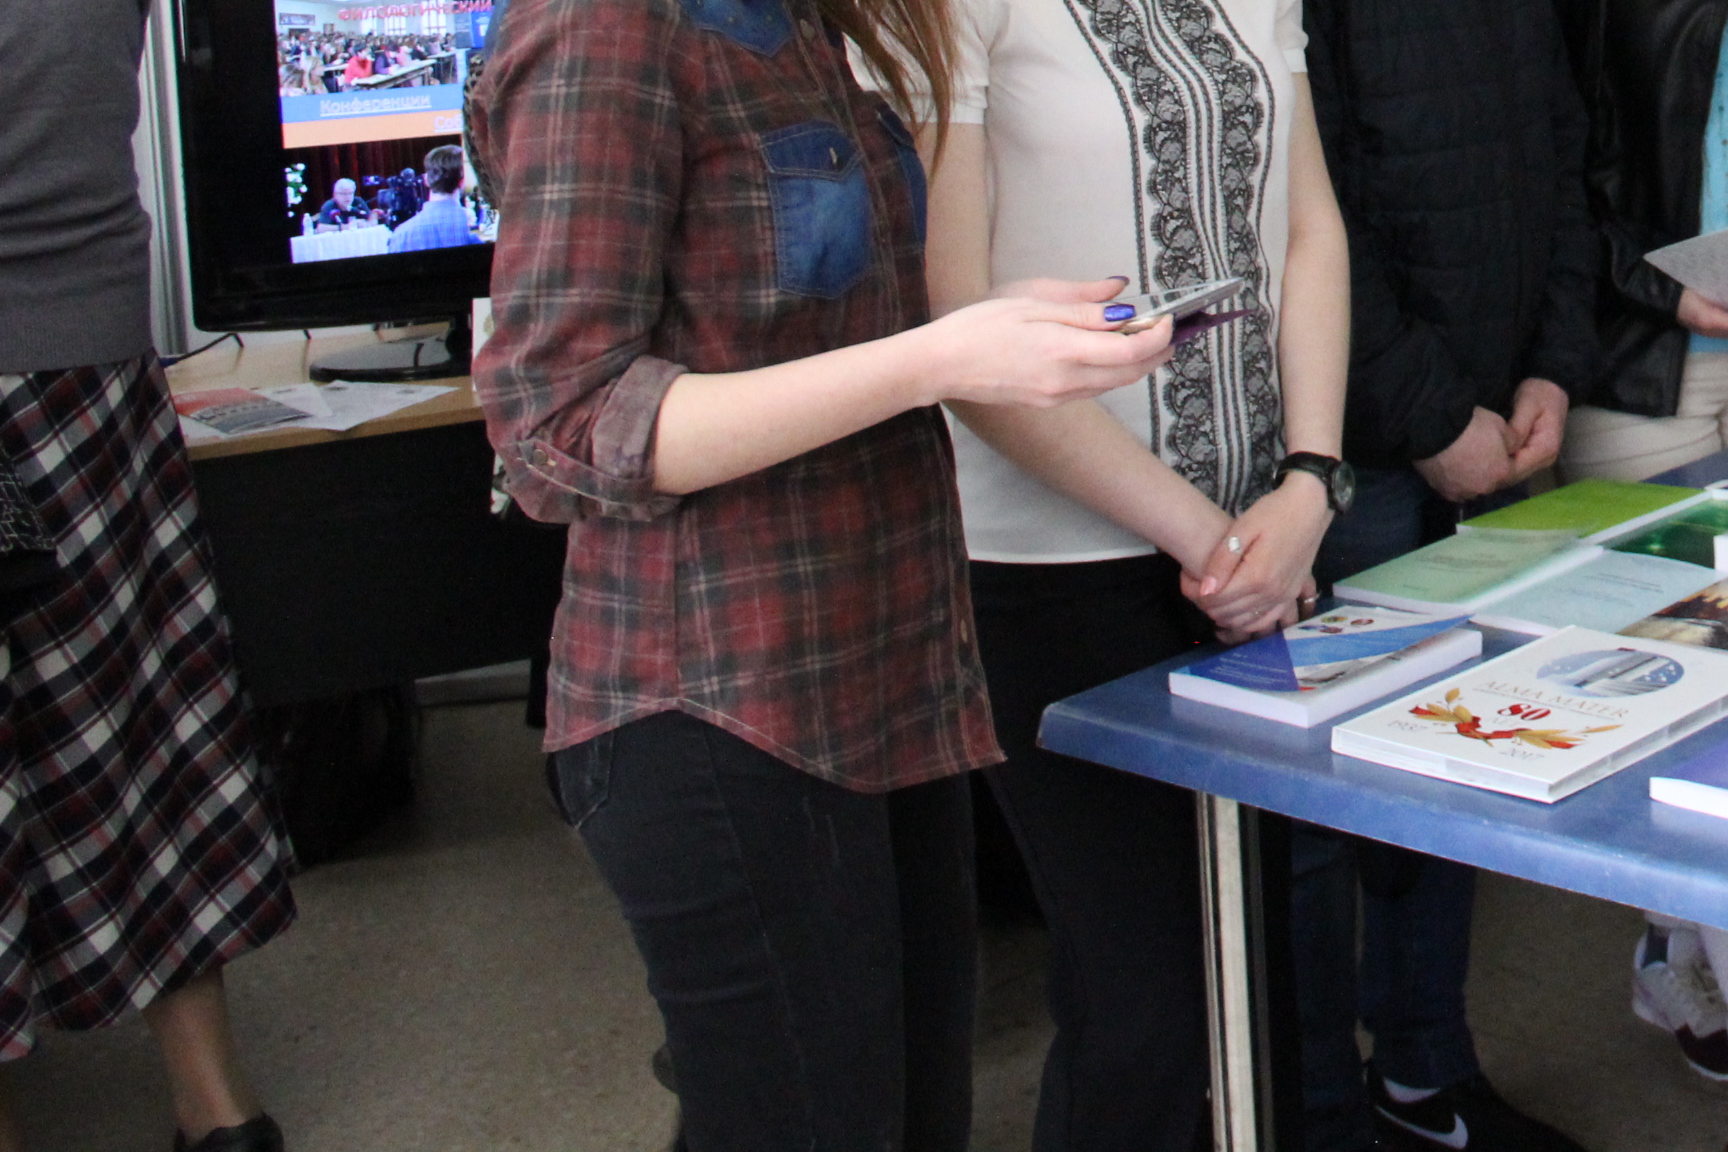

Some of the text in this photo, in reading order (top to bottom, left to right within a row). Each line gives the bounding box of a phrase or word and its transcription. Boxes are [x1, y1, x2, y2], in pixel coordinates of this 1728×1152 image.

[320, 95, 432, 114] Конференции
[1480, 680, 1630, 719] ALMA MATER
[1498, 703, 1551, 721] 80
[1387, 719, 1428, 732] 1937
[1498, 748, 1546, 761] 2017
